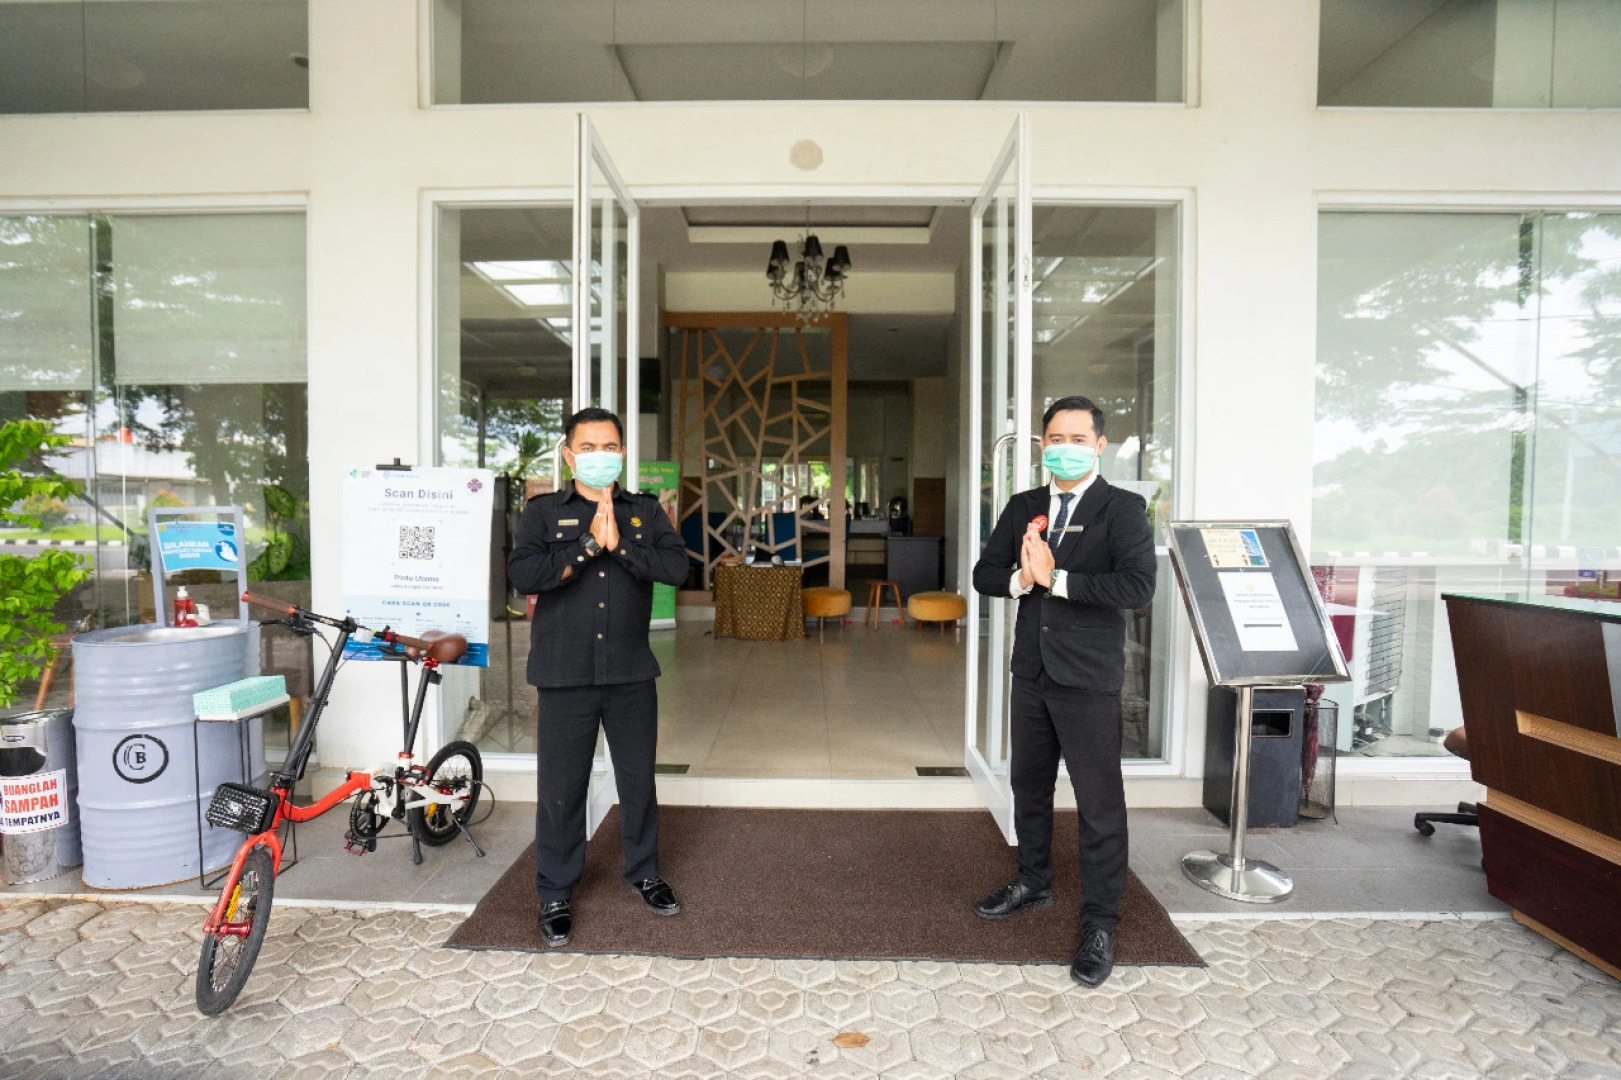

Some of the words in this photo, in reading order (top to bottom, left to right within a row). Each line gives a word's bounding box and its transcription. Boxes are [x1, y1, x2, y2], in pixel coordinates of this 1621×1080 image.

[384, 488, 414, 499] Scan
[418, 489, 454, 500] Disini
[394, 574, 414, 582] Pintu
[415, 575, 440, 583] Utama
[3, 778, 58, 796] BUANGLAH
[4, 792, 59, 814] SAMPAH
[5, 811, 61, 827] TEMPATNYA
